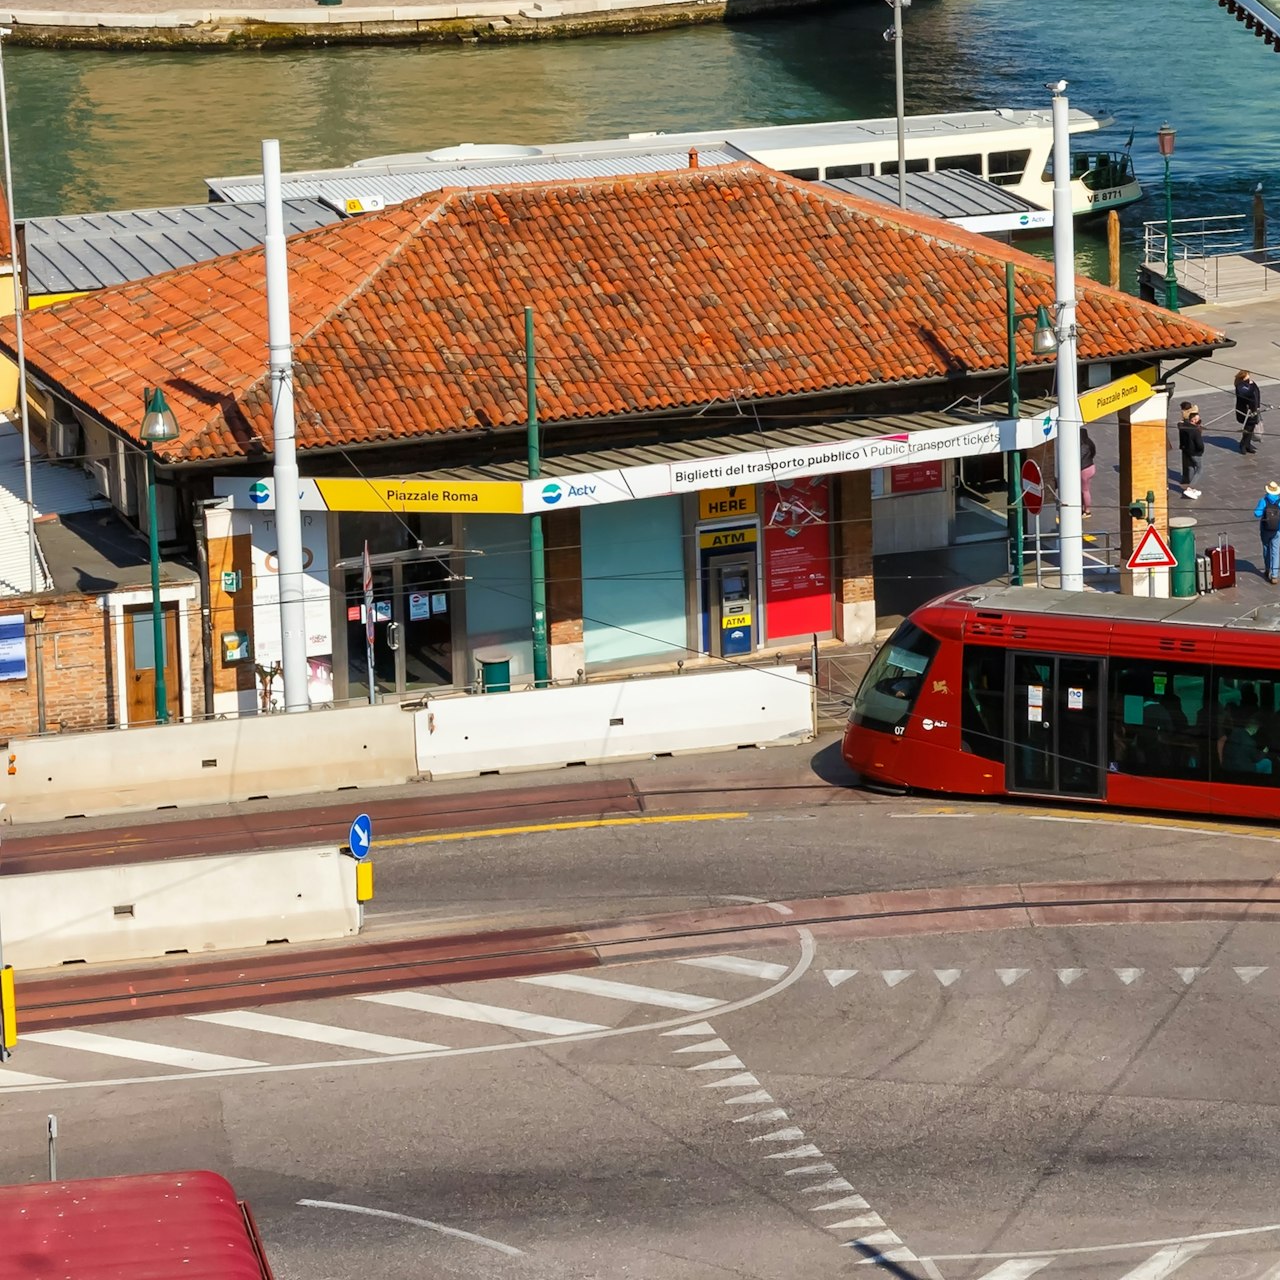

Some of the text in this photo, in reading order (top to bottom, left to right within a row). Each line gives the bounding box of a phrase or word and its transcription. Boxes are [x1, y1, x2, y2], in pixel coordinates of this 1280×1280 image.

[1087, 190, 1122, 204] VE 8771
[1096, 384, 1138, 409] Piazzale Roma
[675, 466, 723, 483] Biglietti
[725, 464, 744, 476] del
[747, 458, 805, 474] trasporto
[807, 451, 860, 467] pubblico
[870, 444, 905, 457] Public
[908, 437, 961, 453] transport
[963, 432, 1000, 446] tickets
[387, 490, 478, 501] Piazzale Roma
[568, 485, 596, 497] Actv
[708, 498, 747, 514] HERE
[712, 532, 745, 546] ATM
[726, 617, 746, 628] ATM
[894, 726, 905, 735] 07
